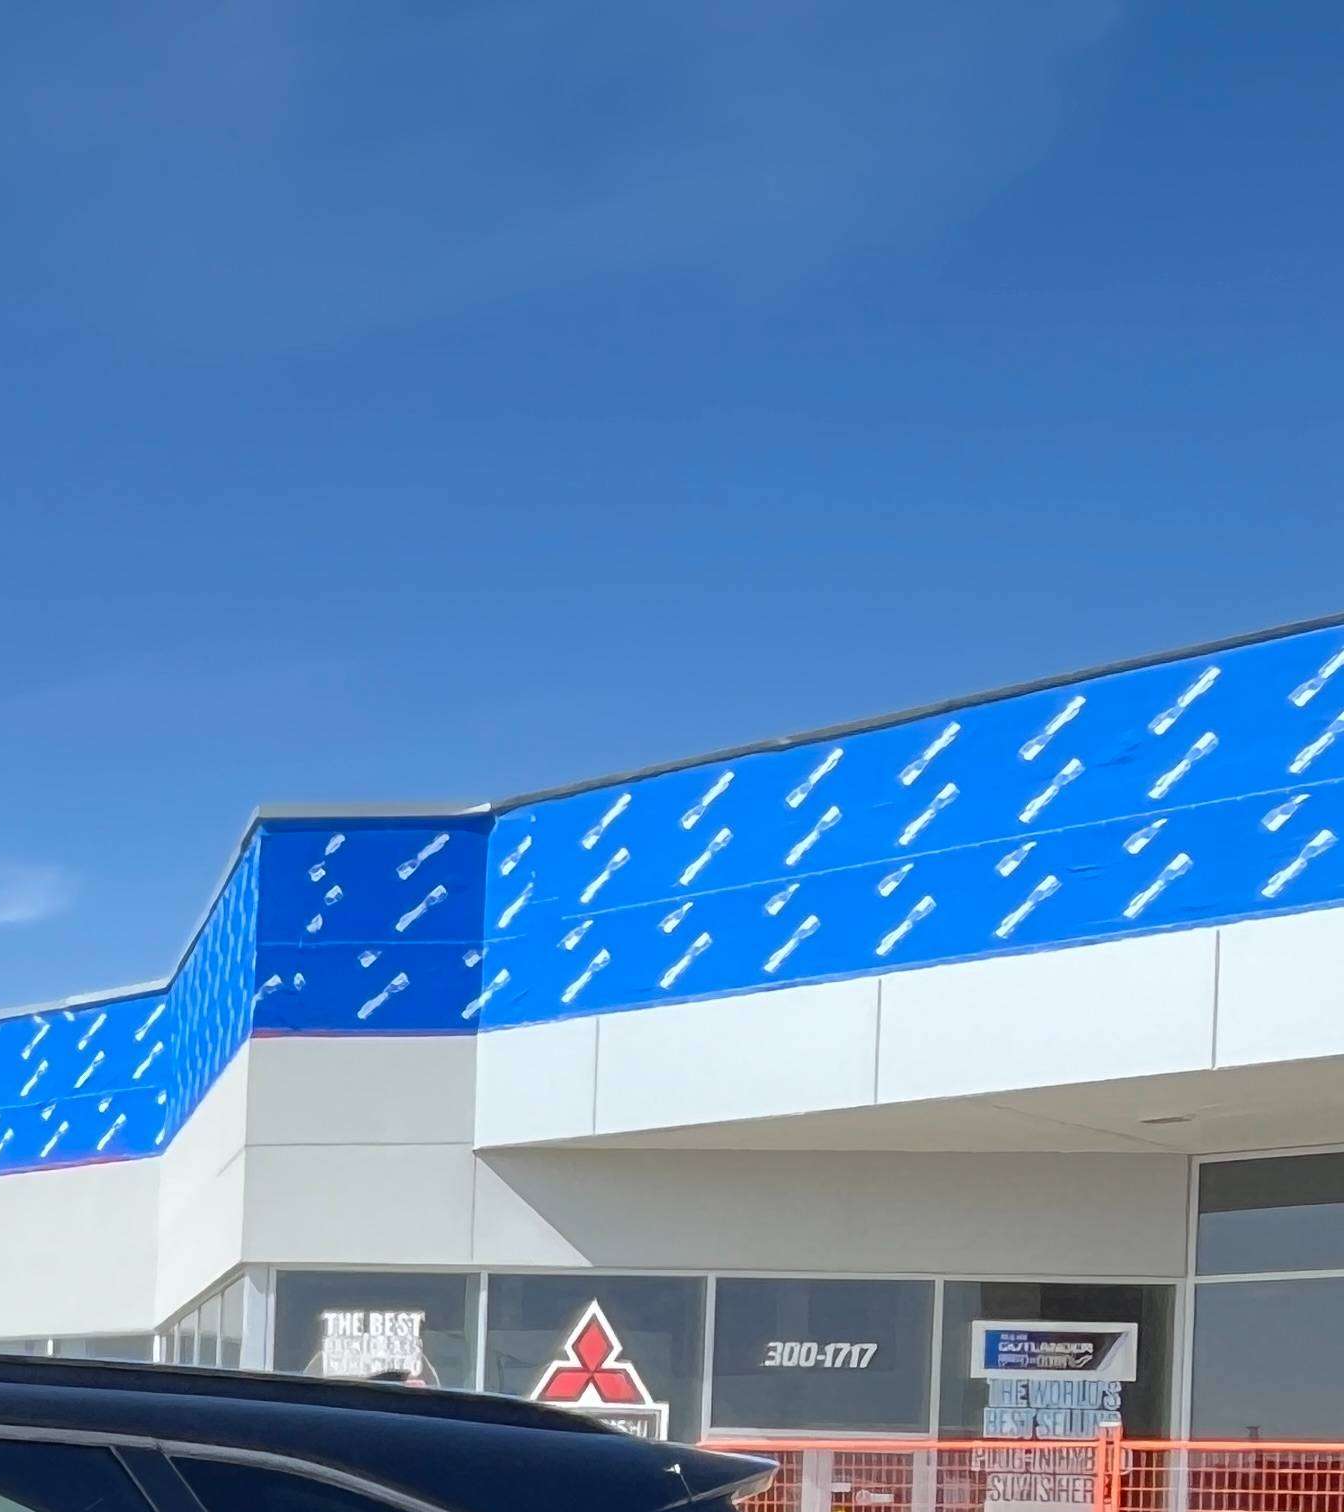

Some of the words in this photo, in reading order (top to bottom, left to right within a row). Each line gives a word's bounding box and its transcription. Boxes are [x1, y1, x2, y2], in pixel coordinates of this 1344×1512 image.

[324, 1311, 365, 1336] THE
[369, 1311, 425, 1337] BEST
[765, 1341, 878, 1368] 300-1717
[983, 1407, 1035, 1438] BEST
[1055, 1474, 1115, 1505] HER
